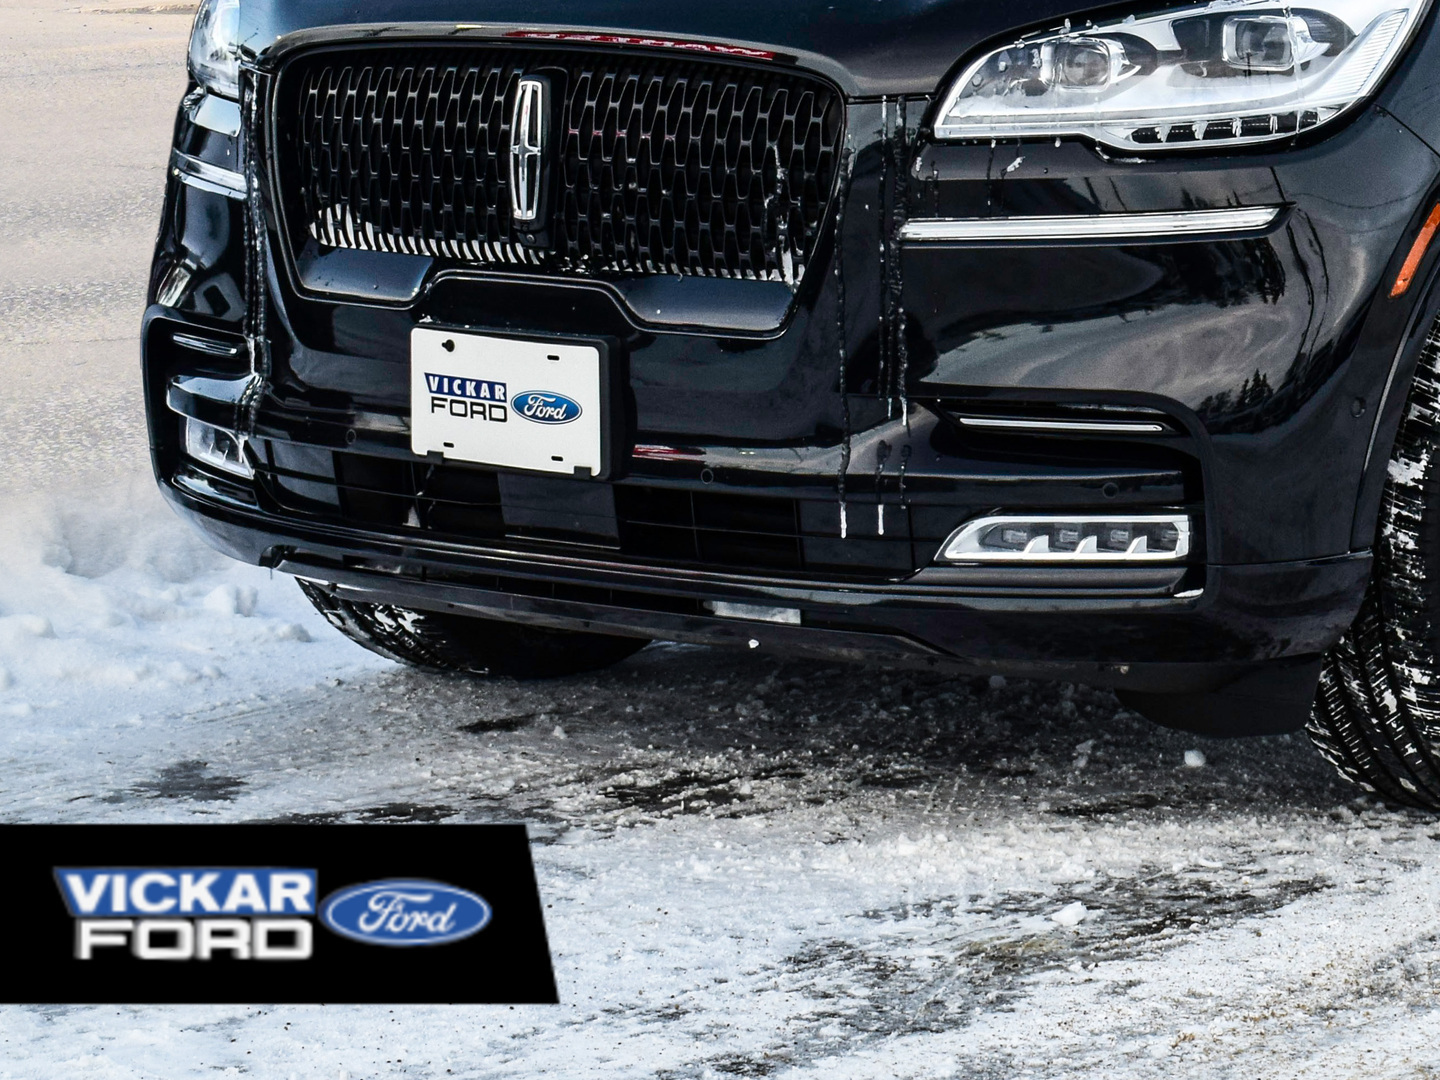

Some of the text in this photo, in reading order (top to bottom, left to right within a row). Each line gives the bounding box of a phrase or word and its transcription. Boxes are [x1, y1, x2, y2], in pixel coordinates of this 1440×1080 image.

[428, 375, 506, 401] VICKAR
[431, 396, 508, 422] FORD
[523, 394, 568, 420] Ford
